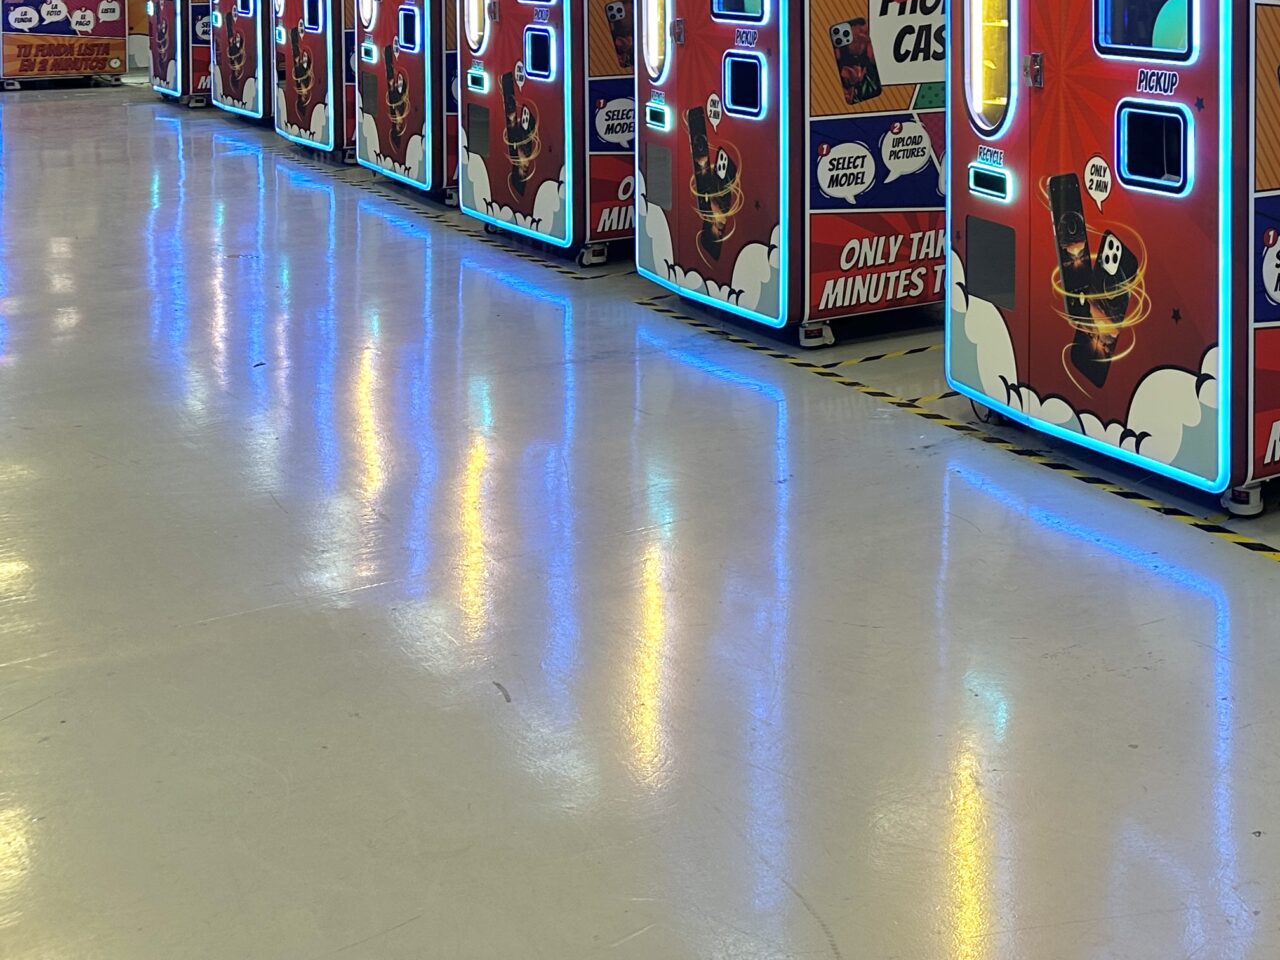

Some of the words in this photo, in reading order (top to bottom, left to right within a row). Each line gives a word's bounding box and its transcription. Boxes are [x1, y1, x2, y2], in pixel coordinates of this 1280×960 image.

[893, 24, 945, 63] CAS
[1138, 71, 1177, 94] PICKUP
[604, 122, 635, 135] MODE
[894, 124, 899, 133] 2
[891, 135, 922, 149] UPLOAD
[889, 147, 926, 161] PICTURES
[979, 146, 1003, 166] RECYCLE
[828, 155, 866, 172] SELECT
[1090, 164, 1107, 177] ONLY
[827, 171, 865, 189] MODEL
[1089, 179, 1093, 190] 2
[1095, 180, 1108, 193] MIN
[1268, 230, 1274, 244] 1
[840, 234, 903, 271] ONLY
[910, 229, 946, 261] TAK
[819, 267, 925, 311] MINUTES
